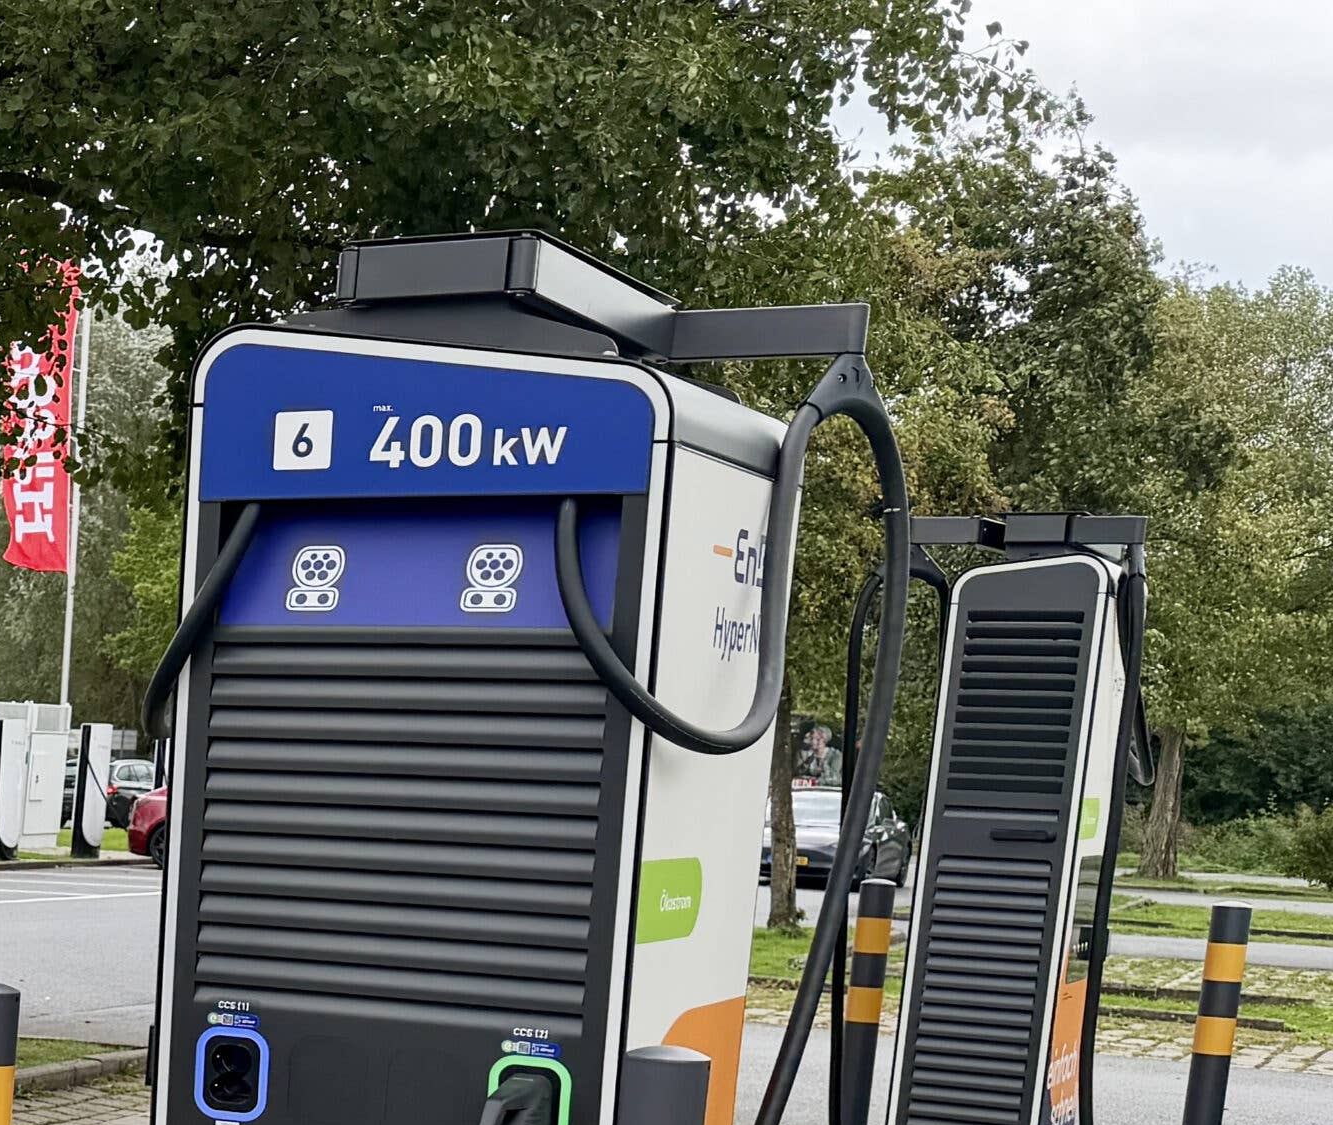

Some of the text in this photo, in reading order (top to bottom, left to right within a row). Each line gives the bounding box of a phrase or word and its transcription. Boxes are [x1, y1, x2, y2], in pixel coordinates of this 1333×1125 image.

[372, 404, 394, 412] max.
[292, 413, 568, 468] 6 400 kW
[218, 1000, 237, 1010] CCS
[513, 1027, 533, 1038] CCS
